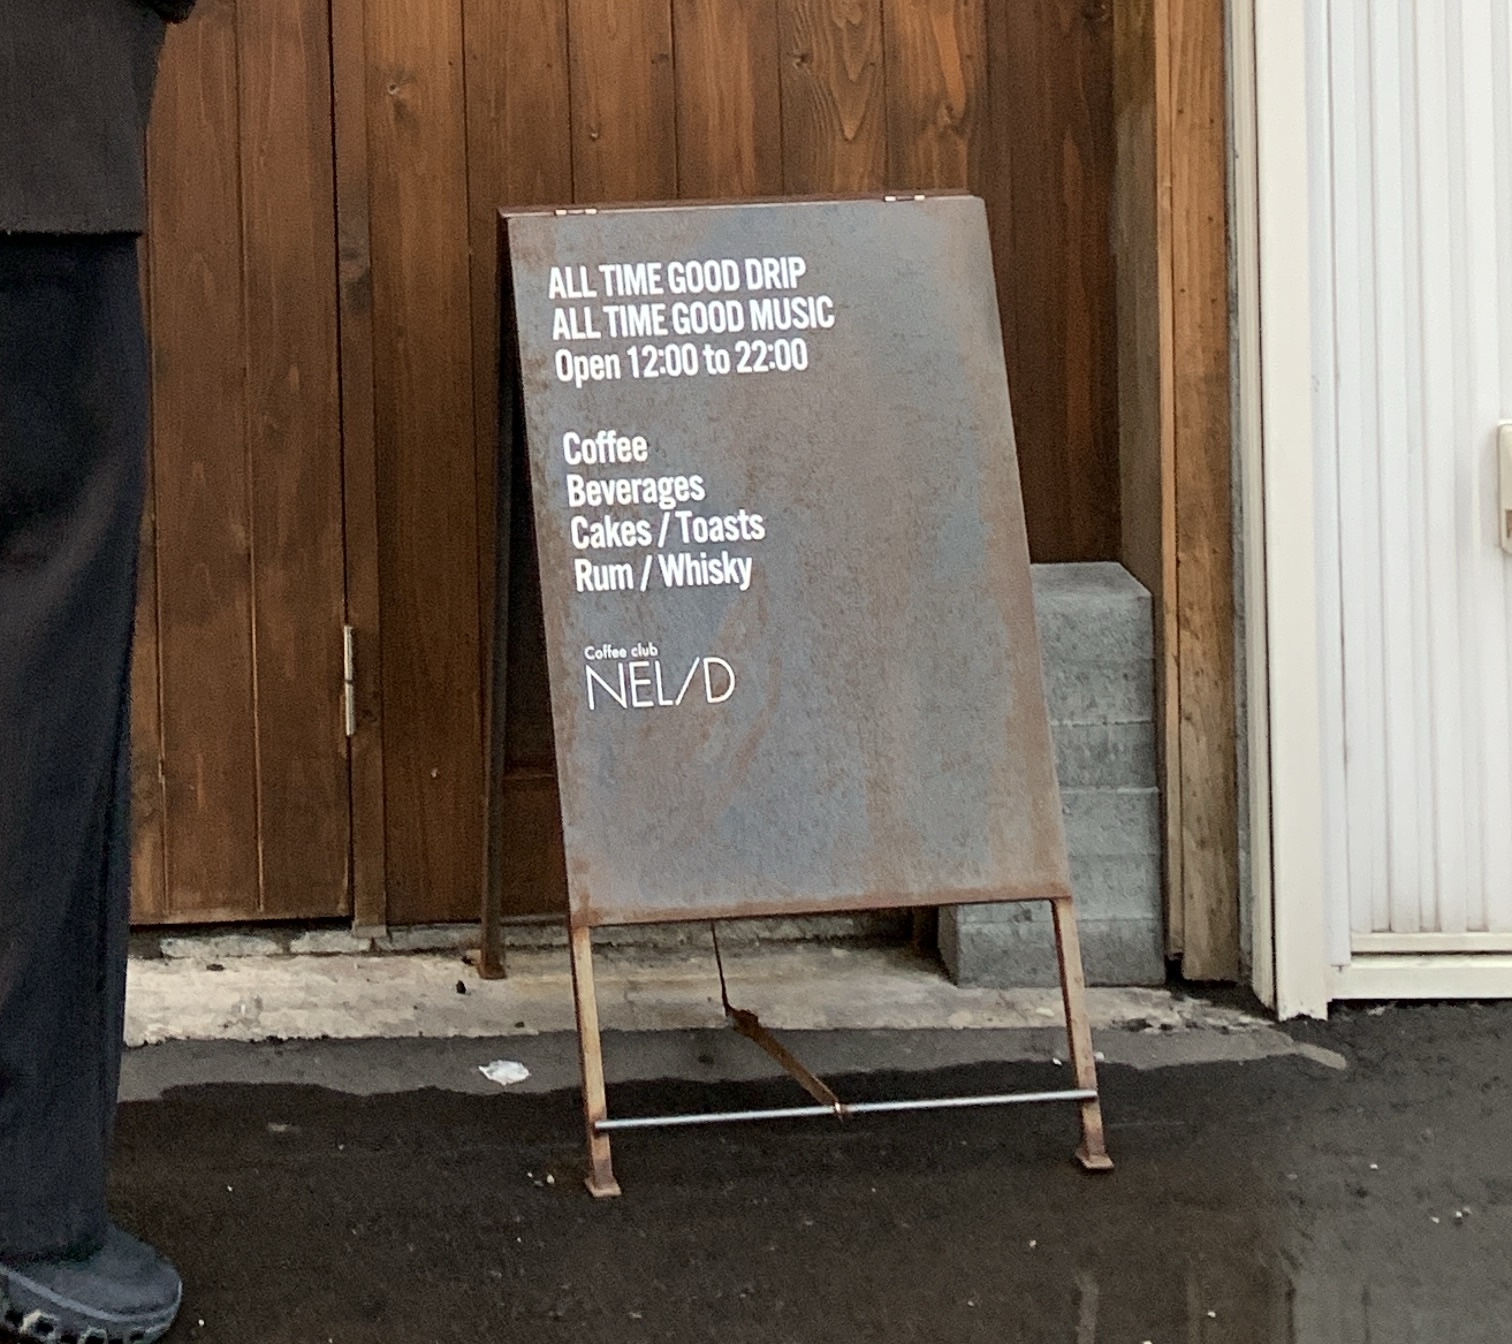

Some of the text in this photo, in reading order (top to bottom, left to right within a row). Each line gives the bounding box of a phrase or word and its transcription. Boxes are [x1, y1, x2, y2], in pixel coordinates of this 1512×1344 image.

[549, 256, 806, 299] ALL TIME GOOD DRIP
[552, 295, 836, 340] ALL TIME GOOD MUSIC
[555, 338, 808, 388] Open 12:00 to 22:00
[562, 430, 648, 465] Coffee
[566, 473, 705, 510] Beverages
[570, 514, 653, 549] Cakes
[675, 509, 766, 544] Toasts
[574, 558, 634, 593] Rum
[657, 550, 753, 591] Whisky
[584, 641, 659, 660] Coffee club
[585, 656, 736, 710] NEL/D
